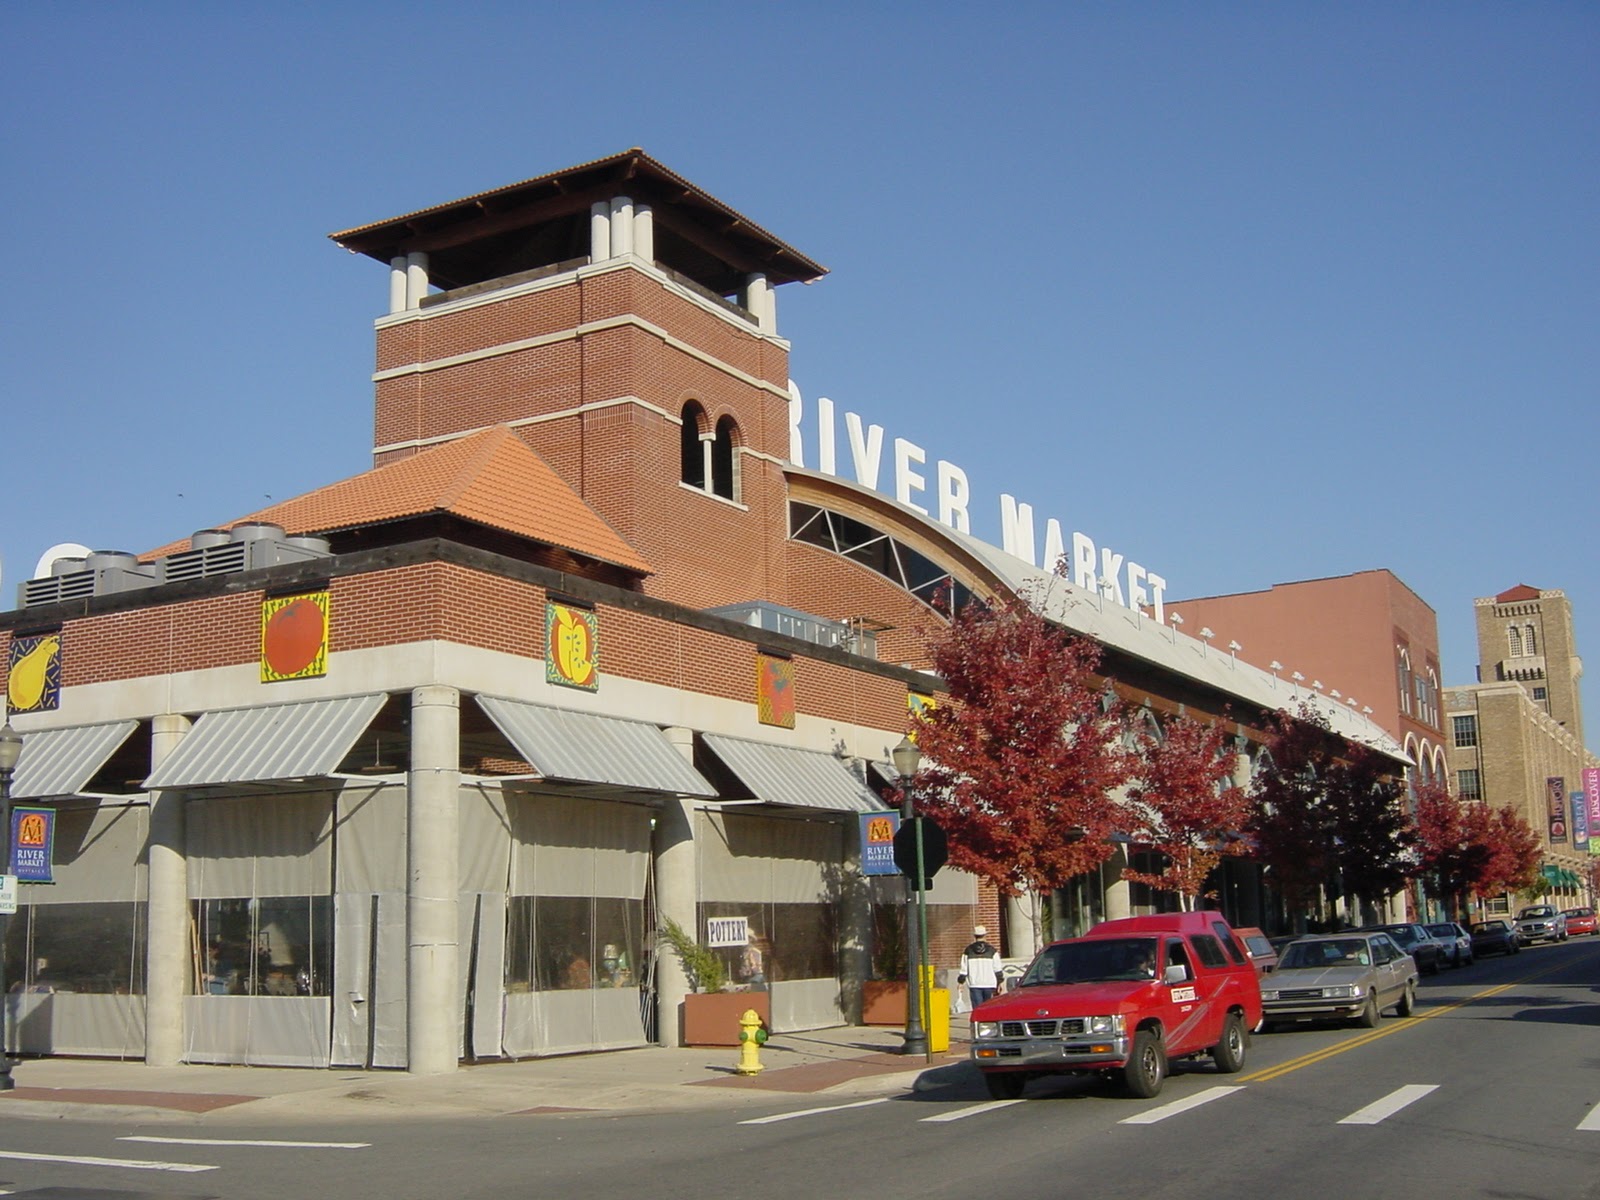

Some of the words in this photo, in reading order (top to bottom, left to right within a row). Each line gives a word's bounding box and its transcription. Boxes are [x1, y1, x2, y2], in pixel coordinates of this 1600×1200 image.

[1001, 493, 1166, 625] MARKET
[1589, 770, 1600, 818] DISCOVER
[17, 850, 45, 860] RIVER
[867, 846, 894, 855] RIVER
[17, 859, 45, 867] MARKET
[709, 920, 747, 942] POTTERY
